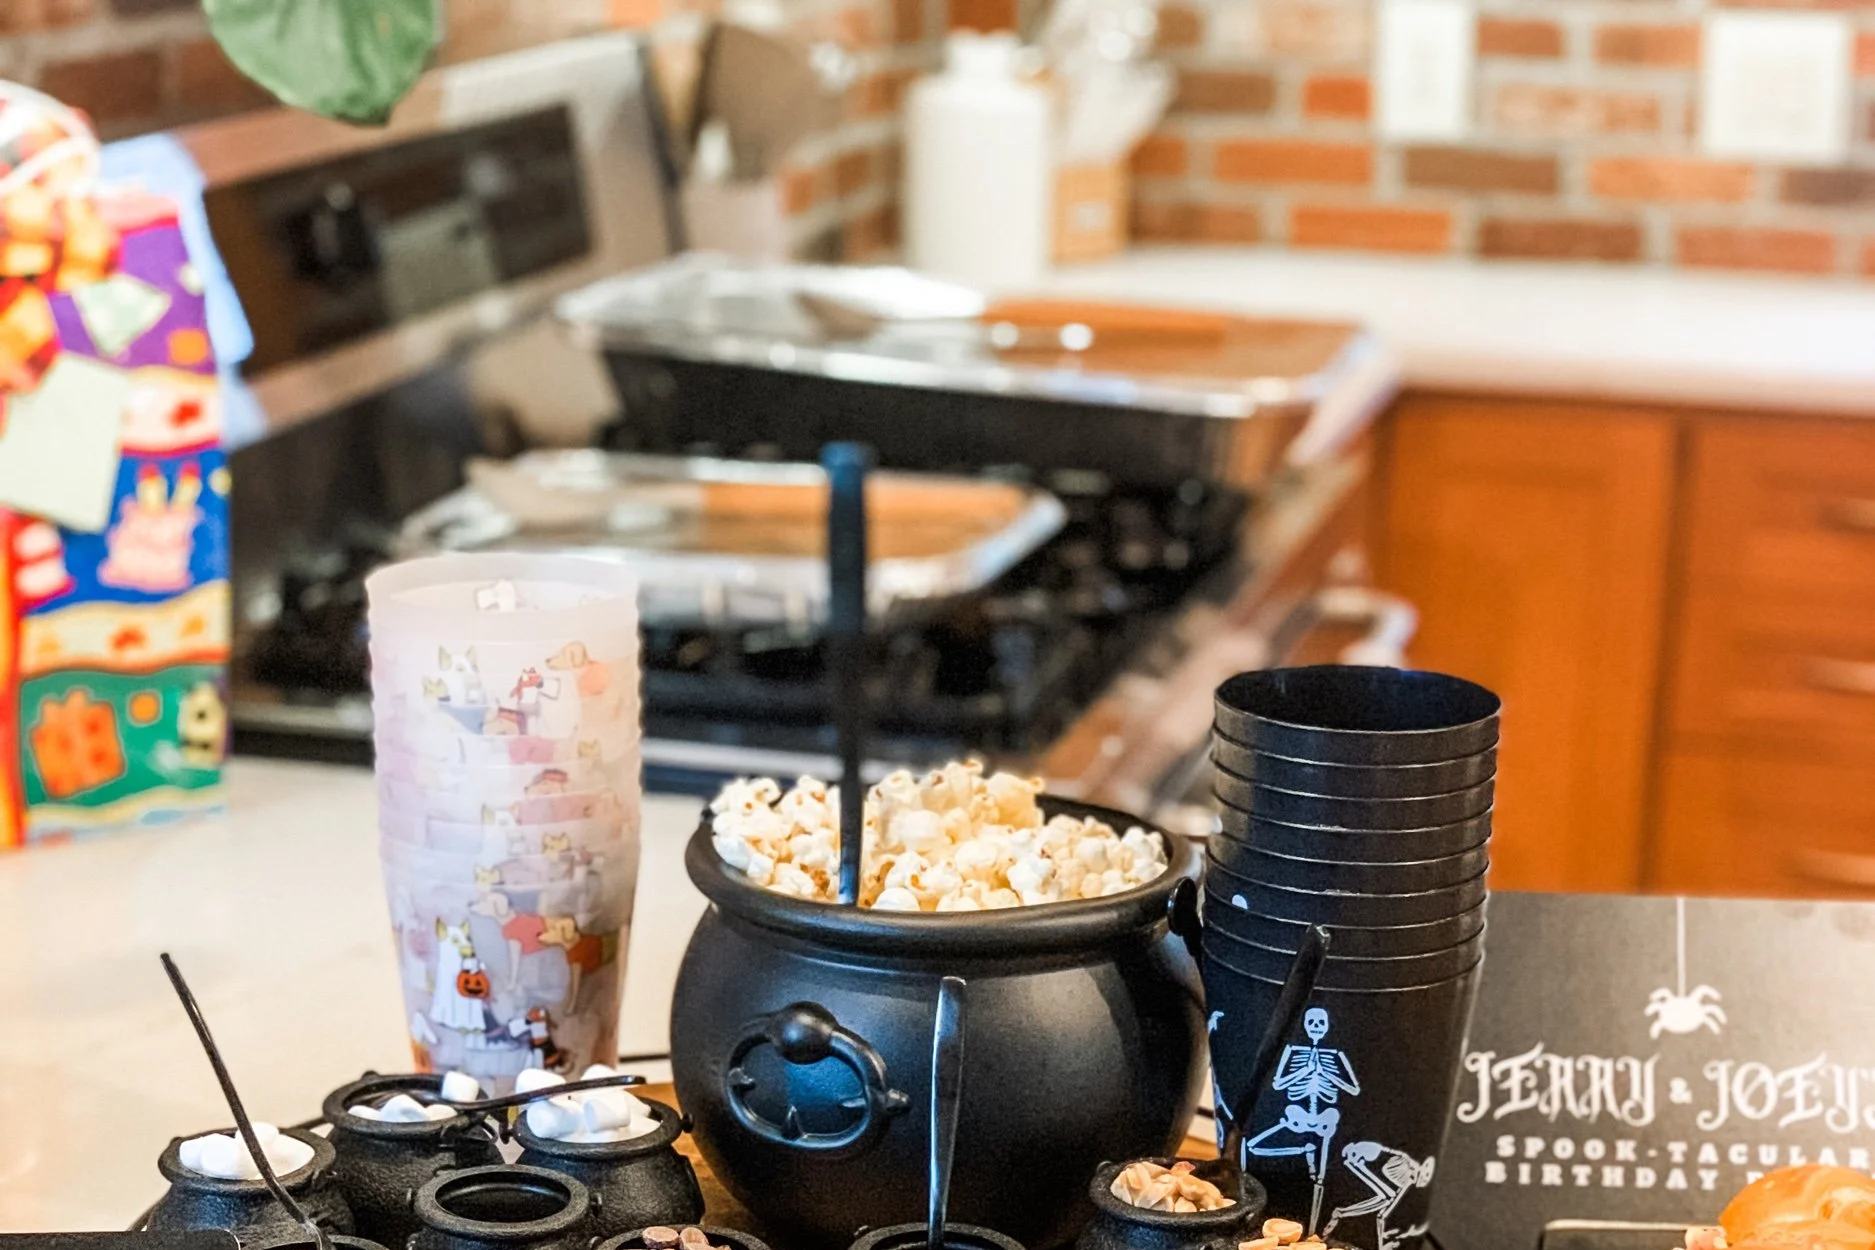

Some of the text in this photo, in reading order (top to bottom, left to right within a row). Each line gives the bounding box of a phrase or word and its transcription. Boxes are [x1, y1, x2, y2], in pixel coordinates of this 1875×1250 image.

[1456, 1041, 1662, 1127] JERRY
[1668, 1077, 1693, 1105] &
[1496, 1134, 1870, 1169] SPOOK-TACULAR
[1484, 1161, 1719, 1191] BIRTHDAY
